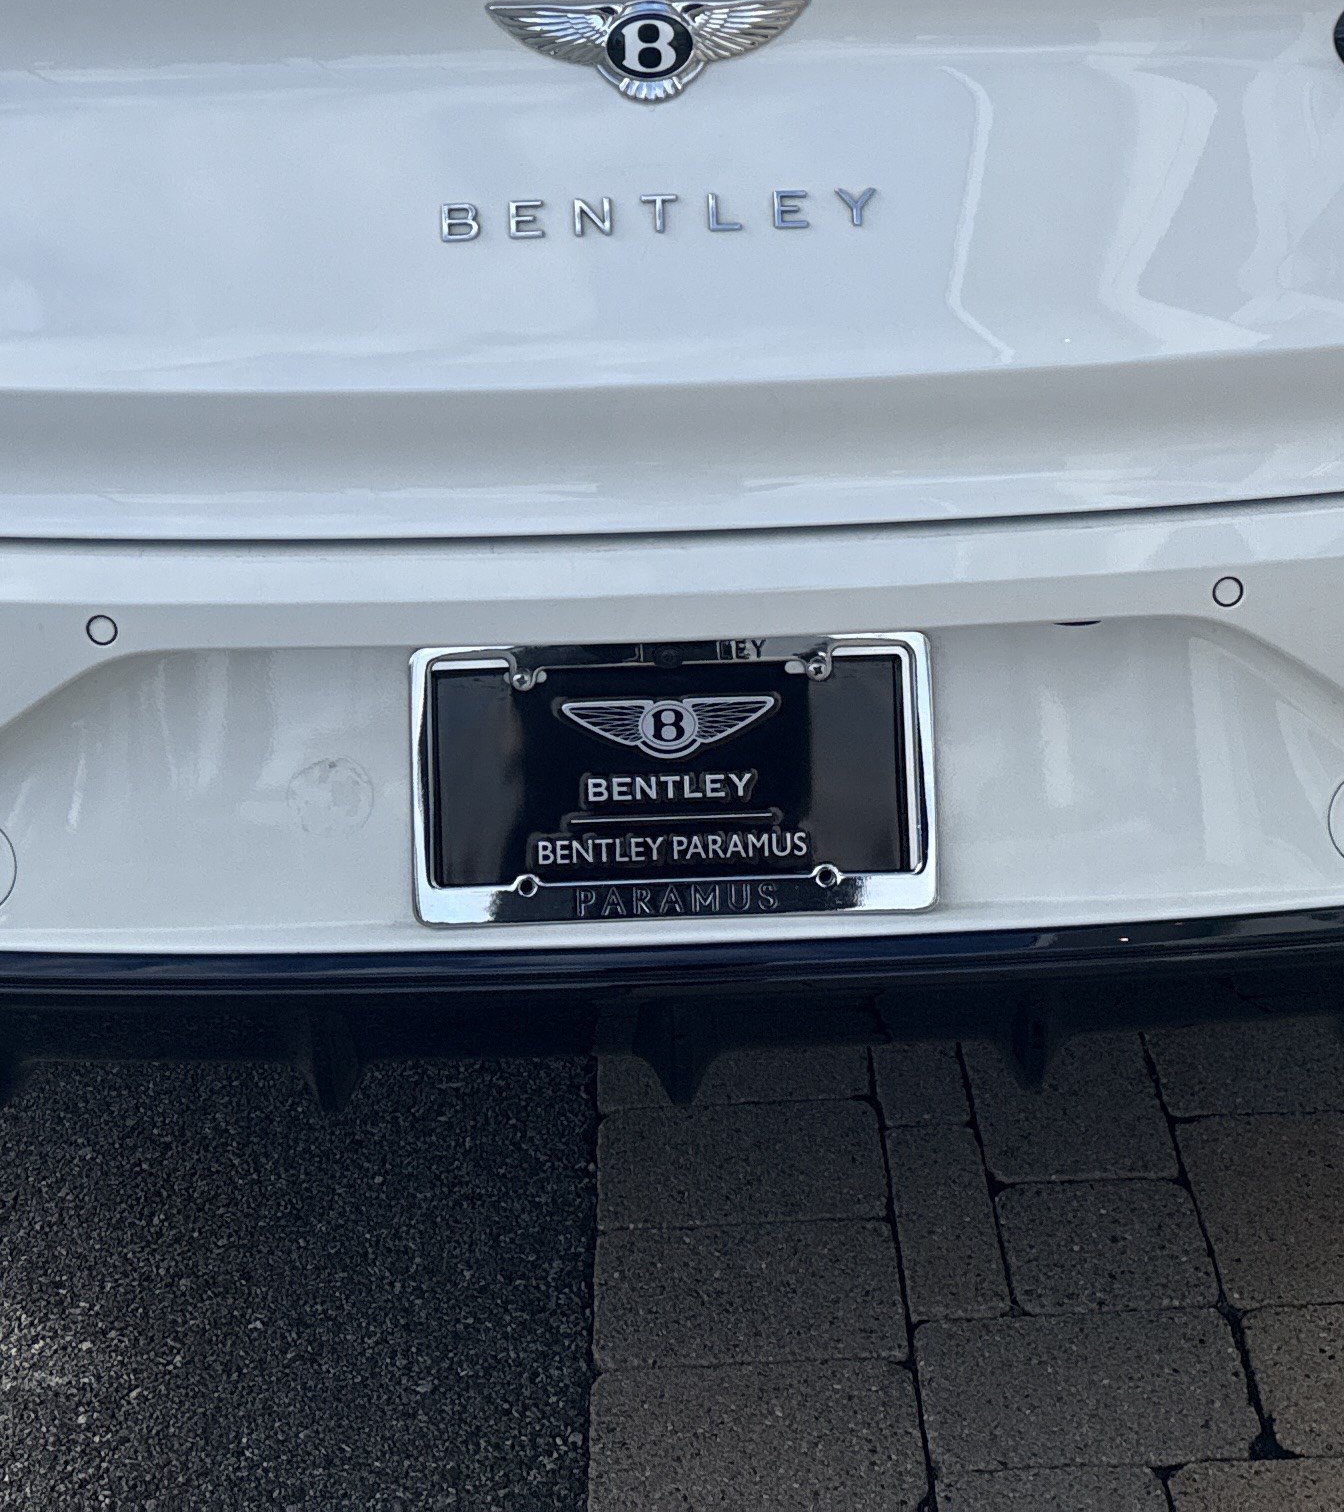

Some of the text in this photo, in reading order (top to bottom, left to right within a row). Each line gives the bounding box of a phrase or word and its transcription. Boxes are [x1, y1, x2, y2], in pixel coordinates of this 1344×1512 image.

[622, 20, 677, 73] B
[440, 187, 876, 243] BENTLEY
[652, 708, 686, 742] B
[587, 773, 752, 802] BENTLEY
[537, 831, 807, 865] BENTLEY PARAMUS
[576, 882, 779, 917] PARAMUS
